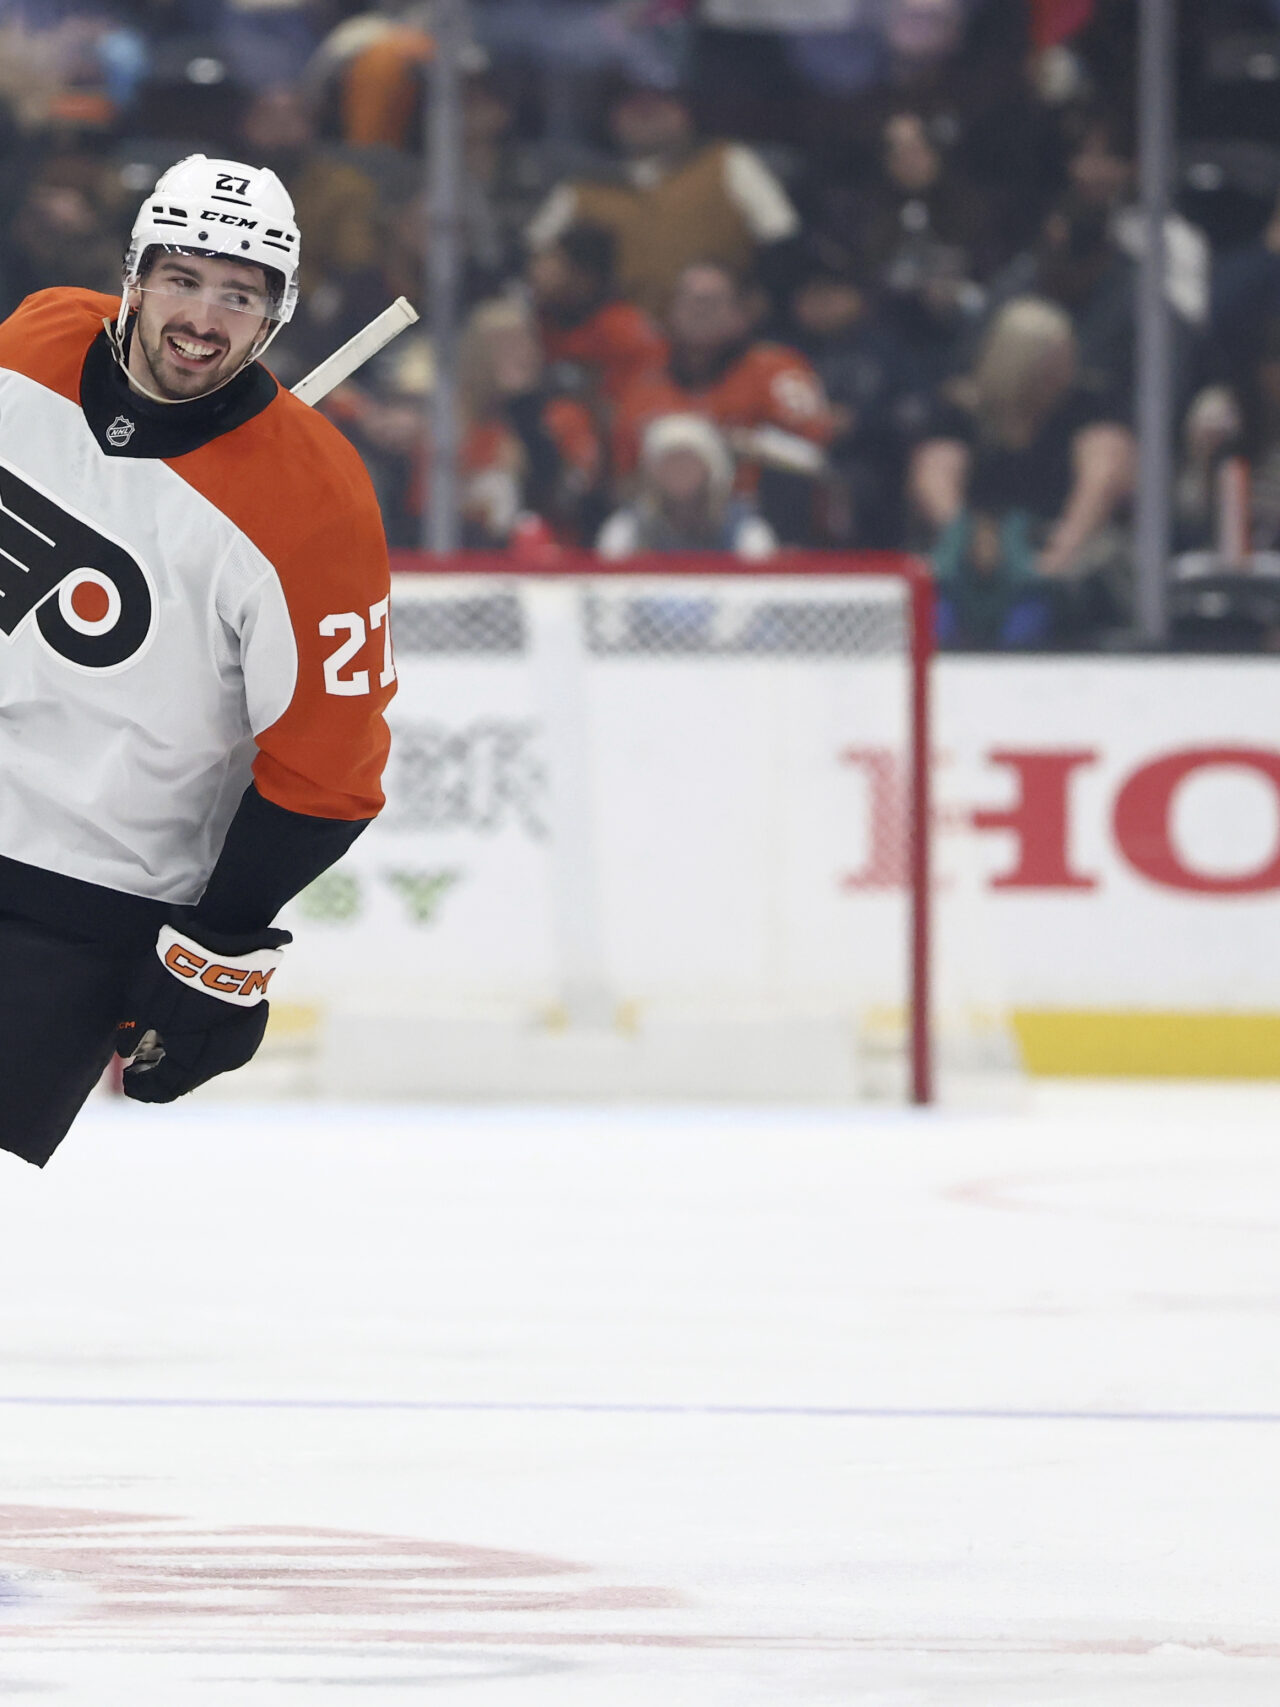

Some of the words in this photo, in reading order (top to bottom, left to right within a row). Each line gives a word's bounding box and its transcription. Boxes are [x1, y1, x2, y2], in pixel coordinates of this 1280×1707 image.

[215, 173, 251, 196] 27
[200, 209, 258, 230] CCM
[318, 593, 397, 697] 27
[164, 943, 277, 996] CCM
